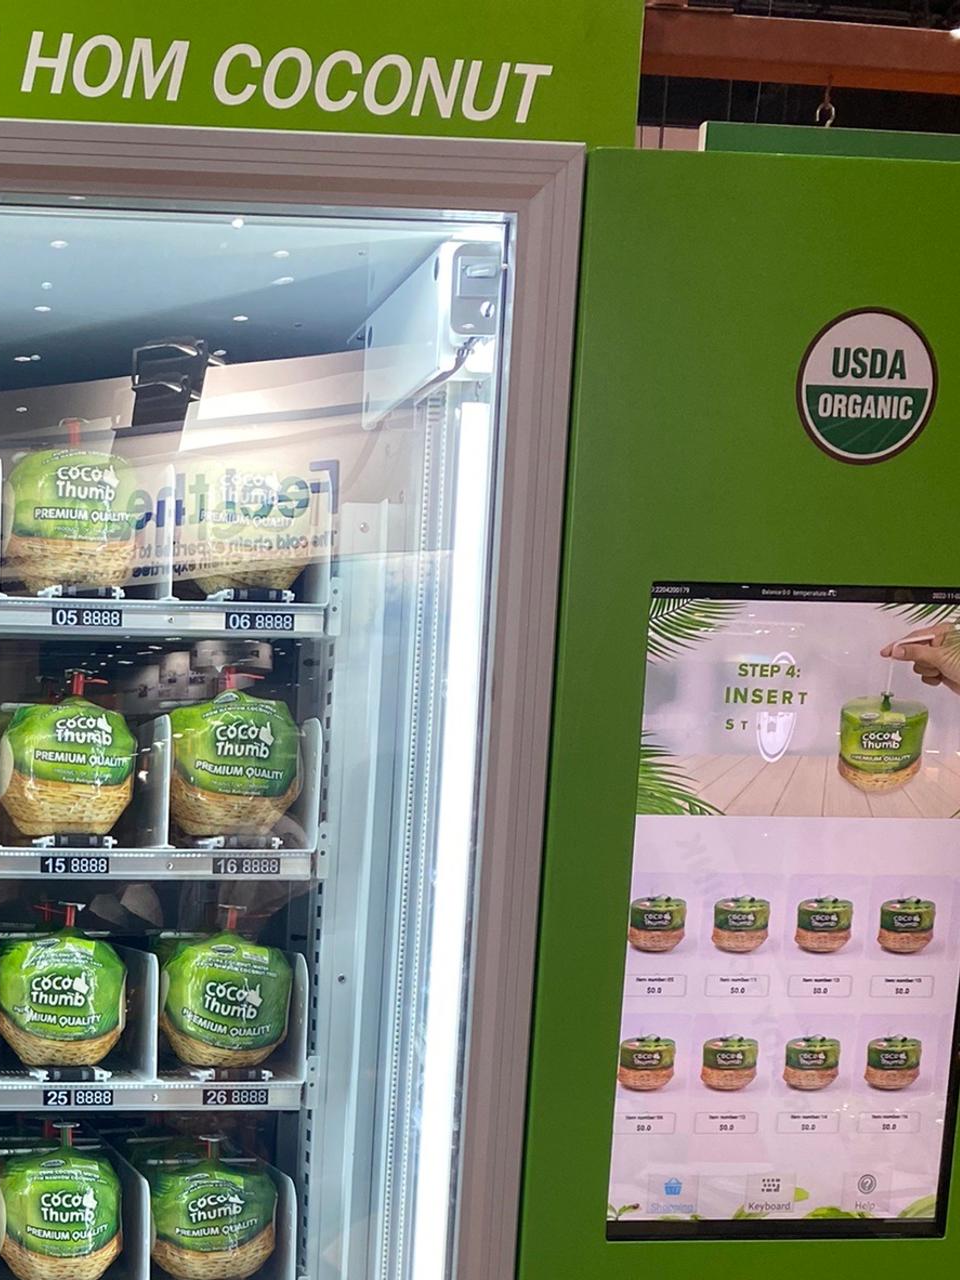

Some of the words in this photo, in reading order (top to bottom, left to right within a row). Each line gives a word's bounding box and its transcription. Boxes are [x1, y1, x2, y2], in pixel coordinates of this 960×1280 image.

[21, 30, 190, 102] HOM
[213, 43, 553, 124] COCONUT
[832, 347, 907, 380] USDA
[818, 392, 914, 420] ORGANIC
[56, 478, 116, 500] Thumb
[34, 507, 88, 521] PREMIUM
[91, 509, 130, 523] QUALITY
[56, 610, 78, 626] 05
[229, 613, 251, 629] 06
[738, 662, 781, 678] STEP
[784, 664, 801, 678] 4:
[724, 687, 808, 705] INSERT
[215, 740, 270, 758] Thumb
[195, 760, 244, 777] PREMIUM
[246, 767, 284, 781] QUALITY
[44, 858, 66, 873] 15
[203, 996, 258, 1020] Thumb
[182, 1008, 227, 1035] PREMIUM
[229, 1024, 272, 1037] QUALITY
[47, 1091, 68, 1106] 25
[41, 1206, 95, 1224] Thumb
[748, 1202, 791, 1212] Keyboard
[855, 1201, 876, 1211] Help
[27, 1225, 70, 1241] PREMIUM
